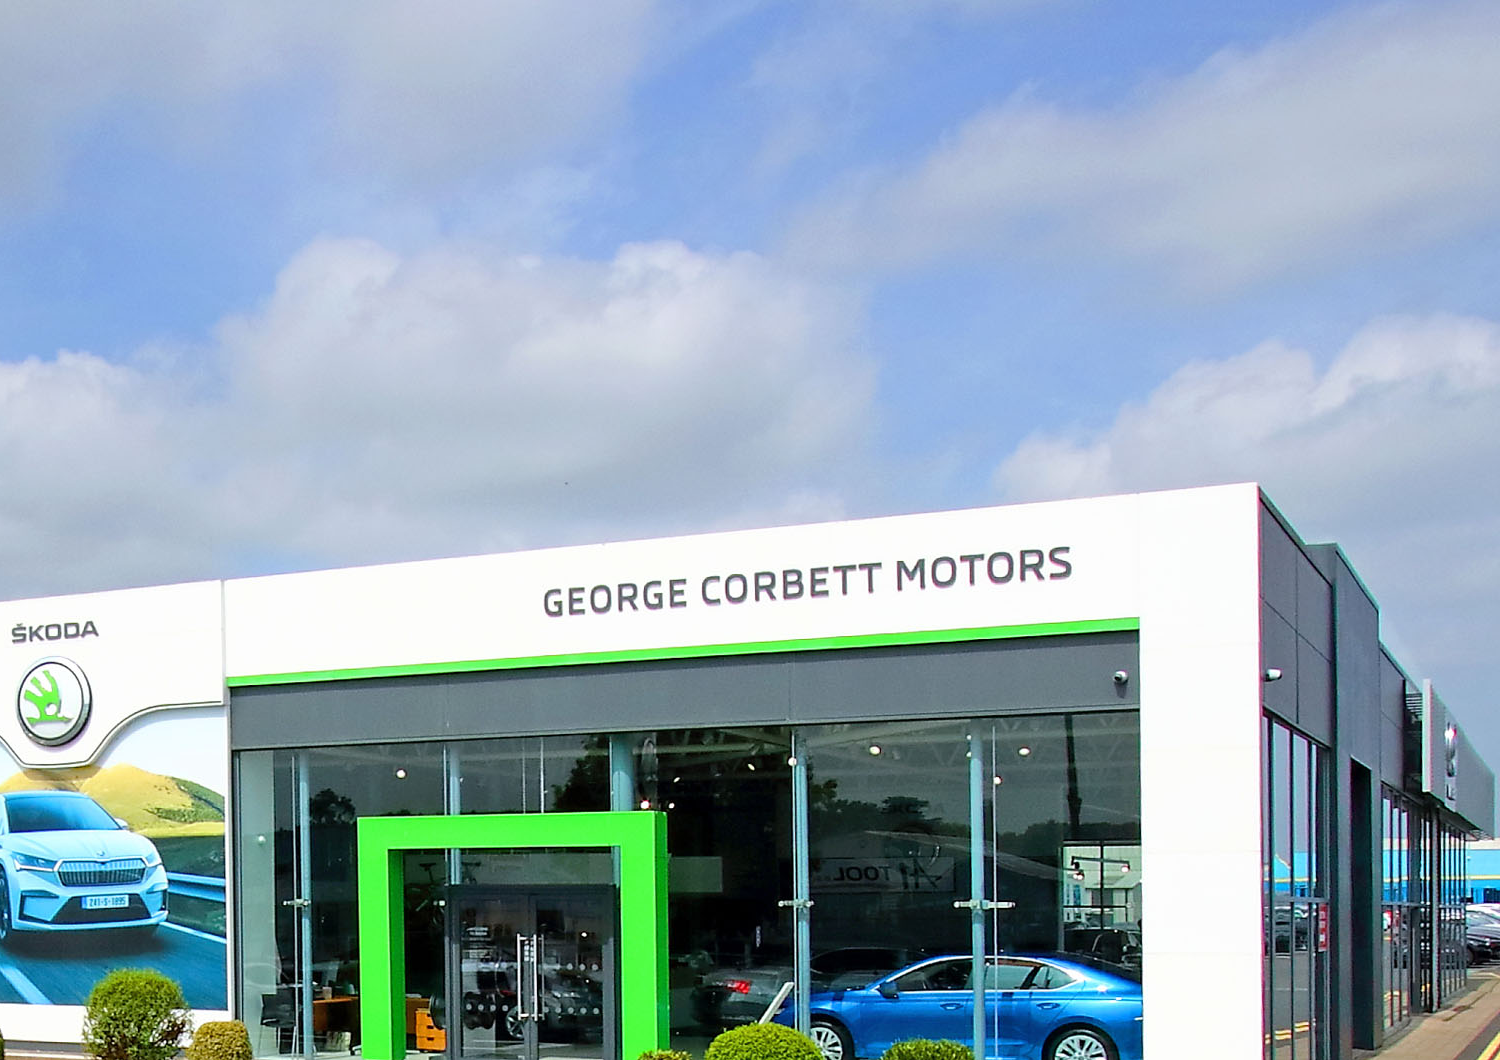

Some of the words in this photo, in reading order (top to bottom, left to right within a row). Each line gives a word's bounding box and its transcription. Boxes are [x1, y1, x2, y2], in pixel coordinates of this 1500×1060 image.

[544, 578, 688, 618] GEORGE
[701, 562, 883, 606] CORBETT
[896, 546, 1073, 591] MOTORS
[11, 620, 100, 644] ŠKODA
